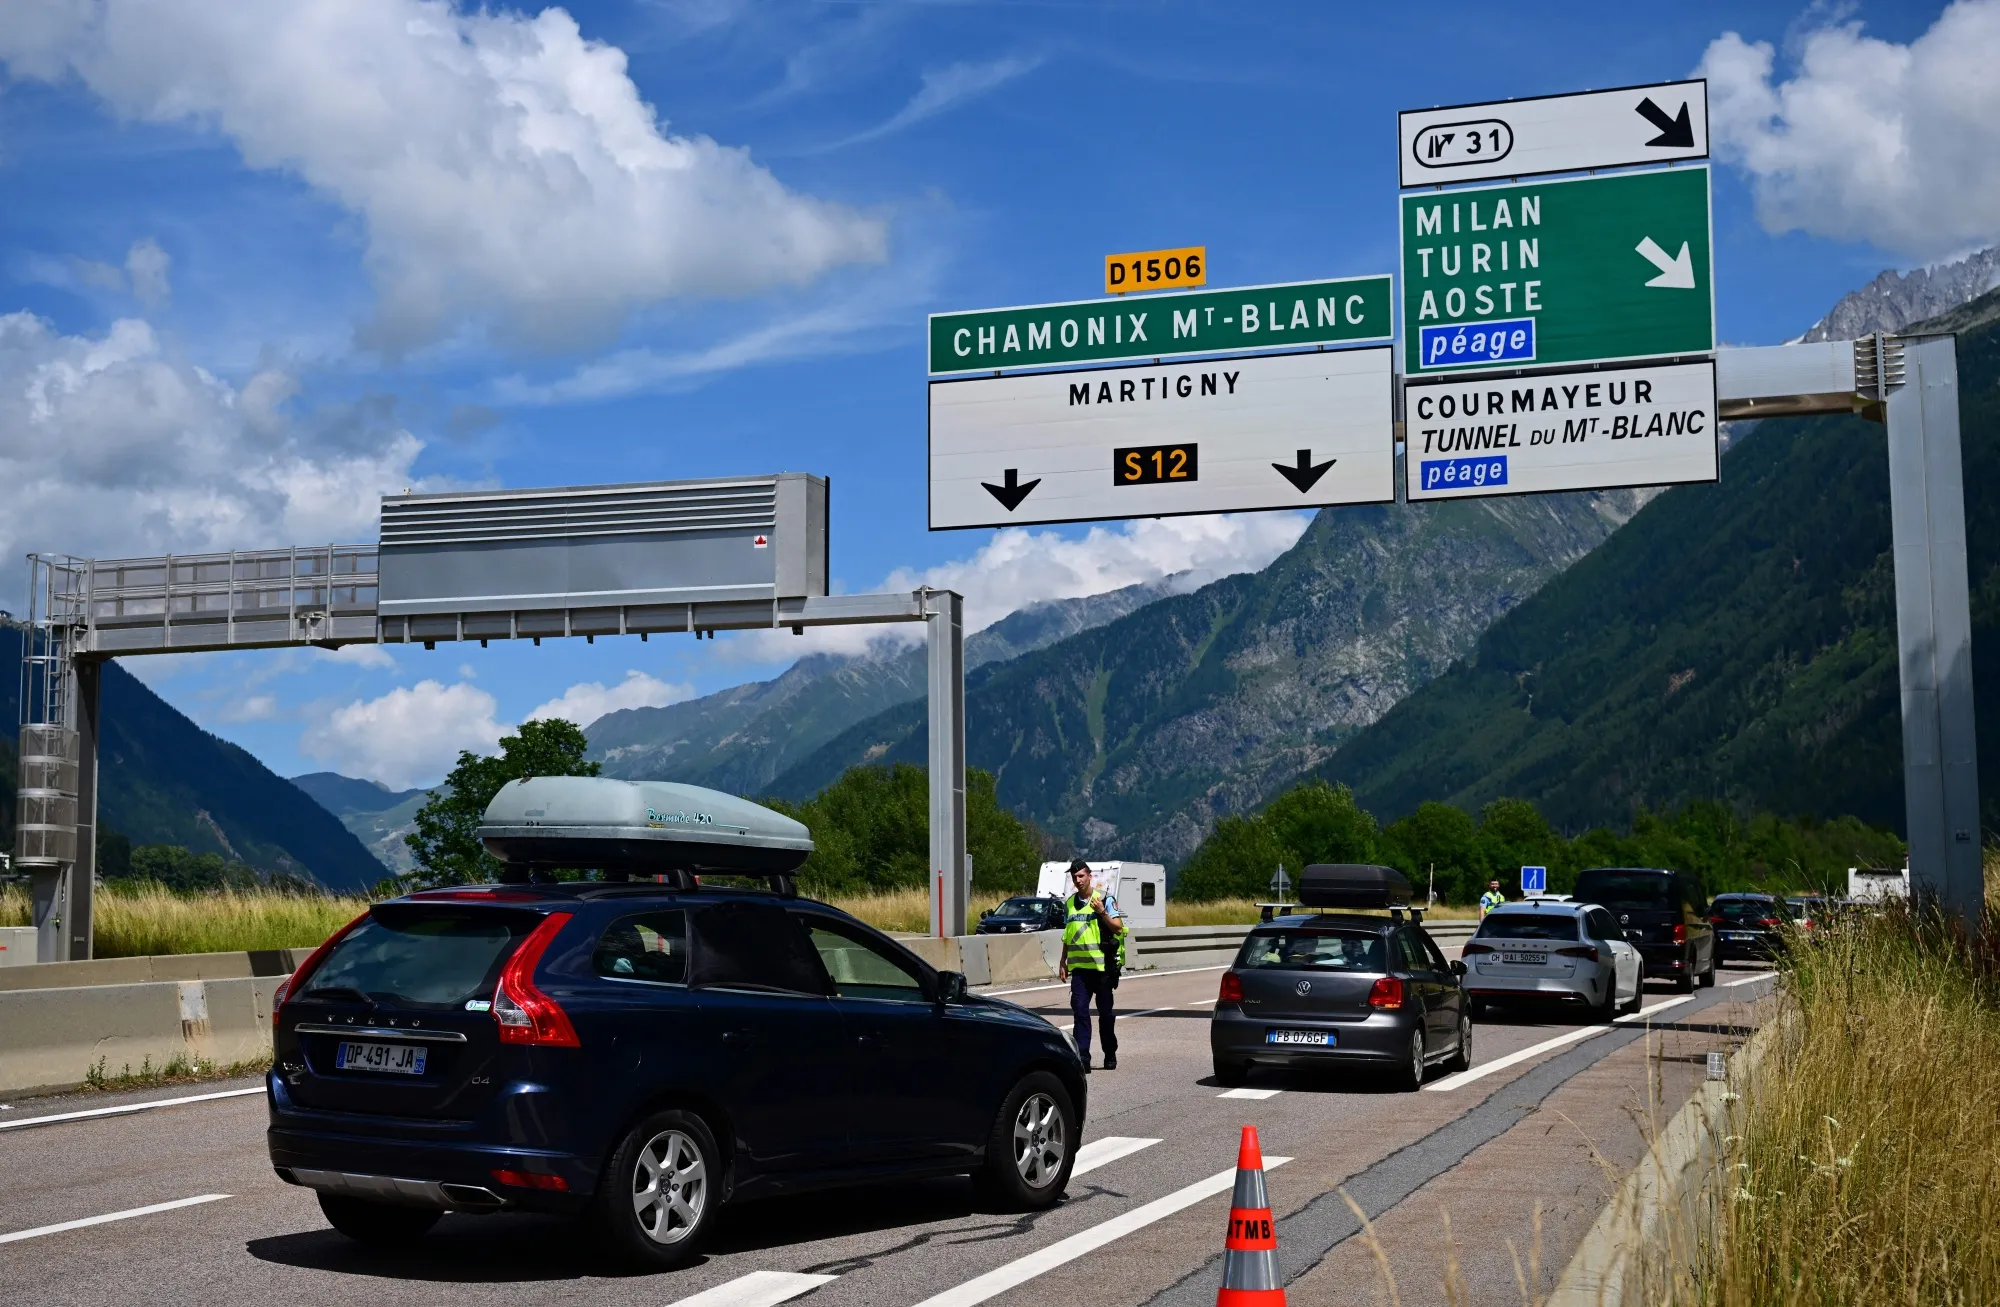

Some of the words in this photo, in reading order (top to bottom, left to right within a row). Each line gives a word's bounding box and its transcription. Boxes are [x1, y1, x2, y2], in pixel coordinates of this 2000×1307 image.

[1466, 128, 1500, 154] 31
[1416, 195, 1541, 237] MILAN
[1110, 255, 1201, 285] D1506
[1416, 238, 1539, 278] TURIN
[1418, 280, 1543, 321] AOSTE
[953, 312, 1148, 357] CHAMONIX
[1429, 327, 1526, 363] péage
[1069, 371, 1240, 406] MARTIGNY
[1417, 380, 1652, 420] COURMAYEUR
[1421, 423, 1521, 454] TUNNEL
[1530, 428, 1556, 446] DU
[1124, 449, 1188, 481] S12
[1427, 460, 1502, 489] péage
[645, 807, 690, 824] Bermude
[693, 812, 713, 825] 420
[1491, 953, 1500, 961] CH
[1276, 1030, 1289, 1042] FB
[1293, 1031, 1328, 1044] 076GF
